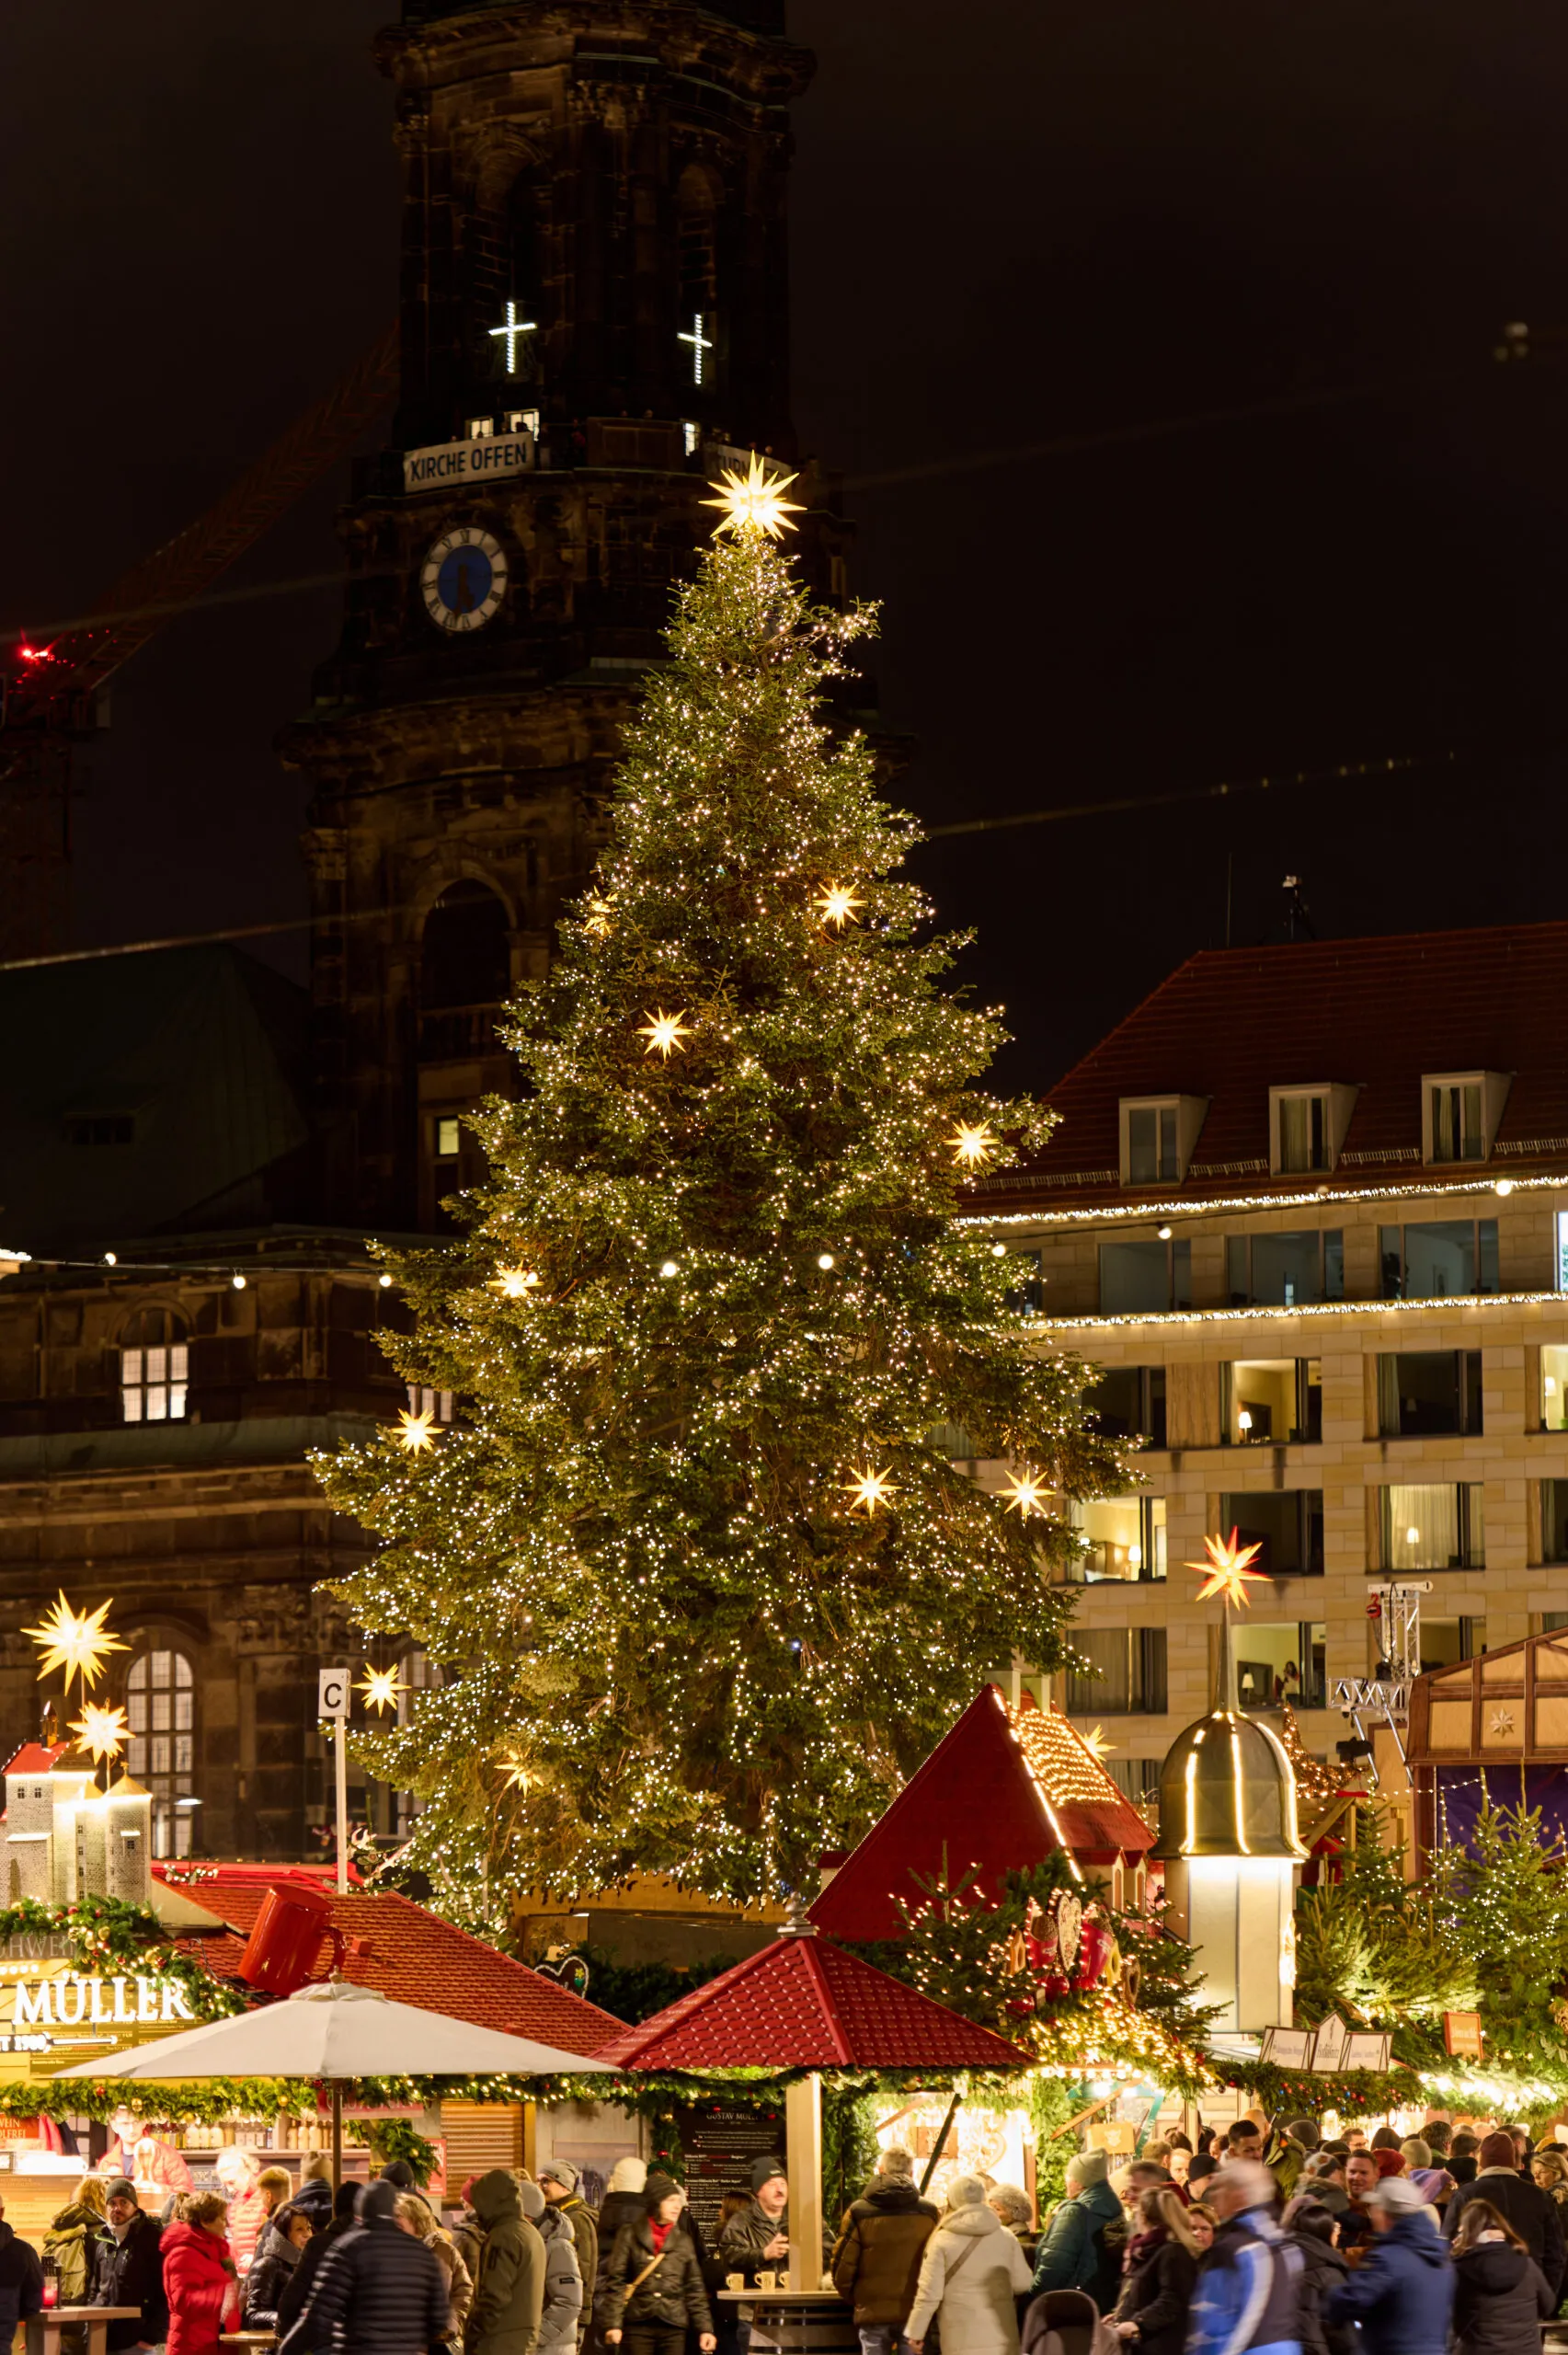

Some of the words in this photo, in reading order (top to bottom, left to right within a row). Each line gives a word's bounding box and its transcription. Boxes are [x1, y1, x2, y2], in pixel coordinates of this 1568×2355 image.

[410, 451, 466, 481] KIRCHE
[471, 442, 527, 471] OFFEN
[324, 1683, 342, 1709] C
[11, 1970, 195, 2025] MÜLLER
